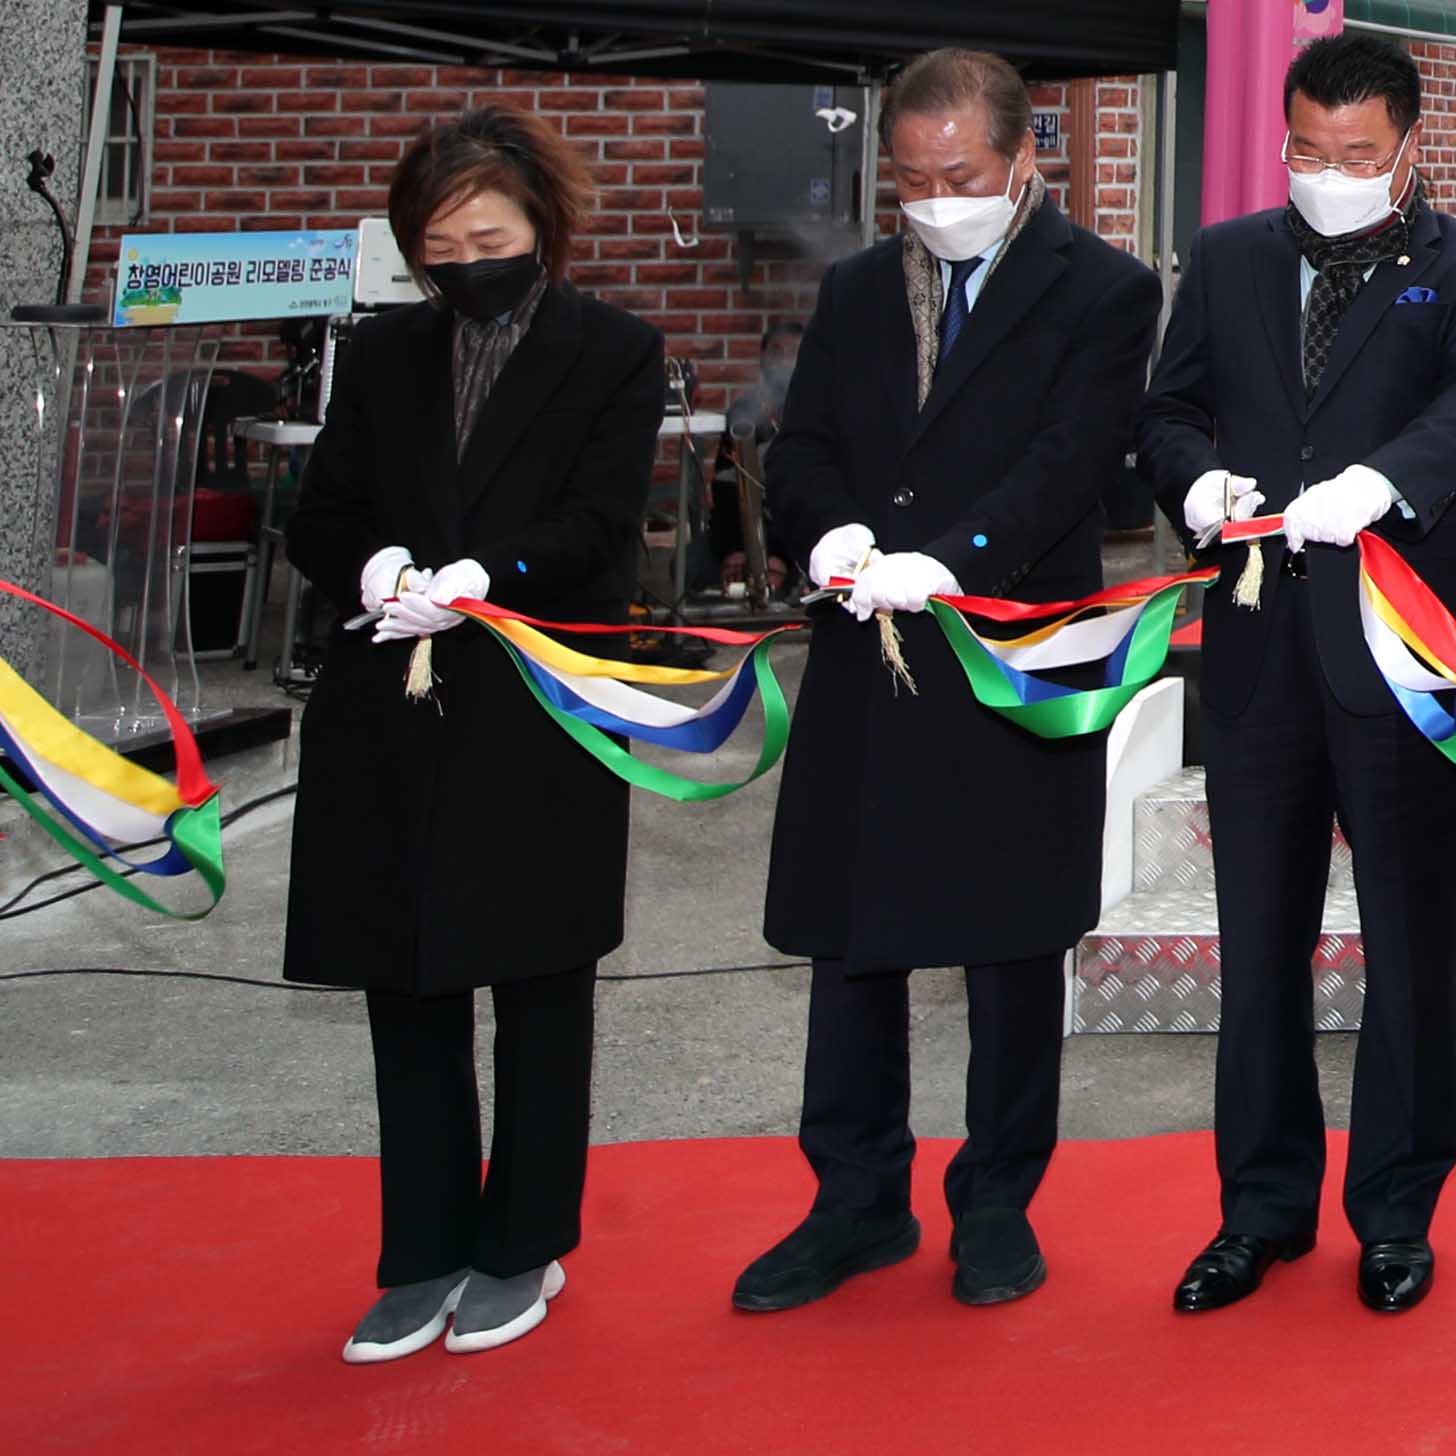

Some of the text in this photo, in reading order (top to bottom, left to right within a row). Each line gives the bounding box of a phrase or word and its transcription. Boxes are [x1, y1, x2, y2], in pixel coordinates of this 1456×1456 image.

[127, 257, 351, 290] 창영어린이공원 리모델링 준공식
